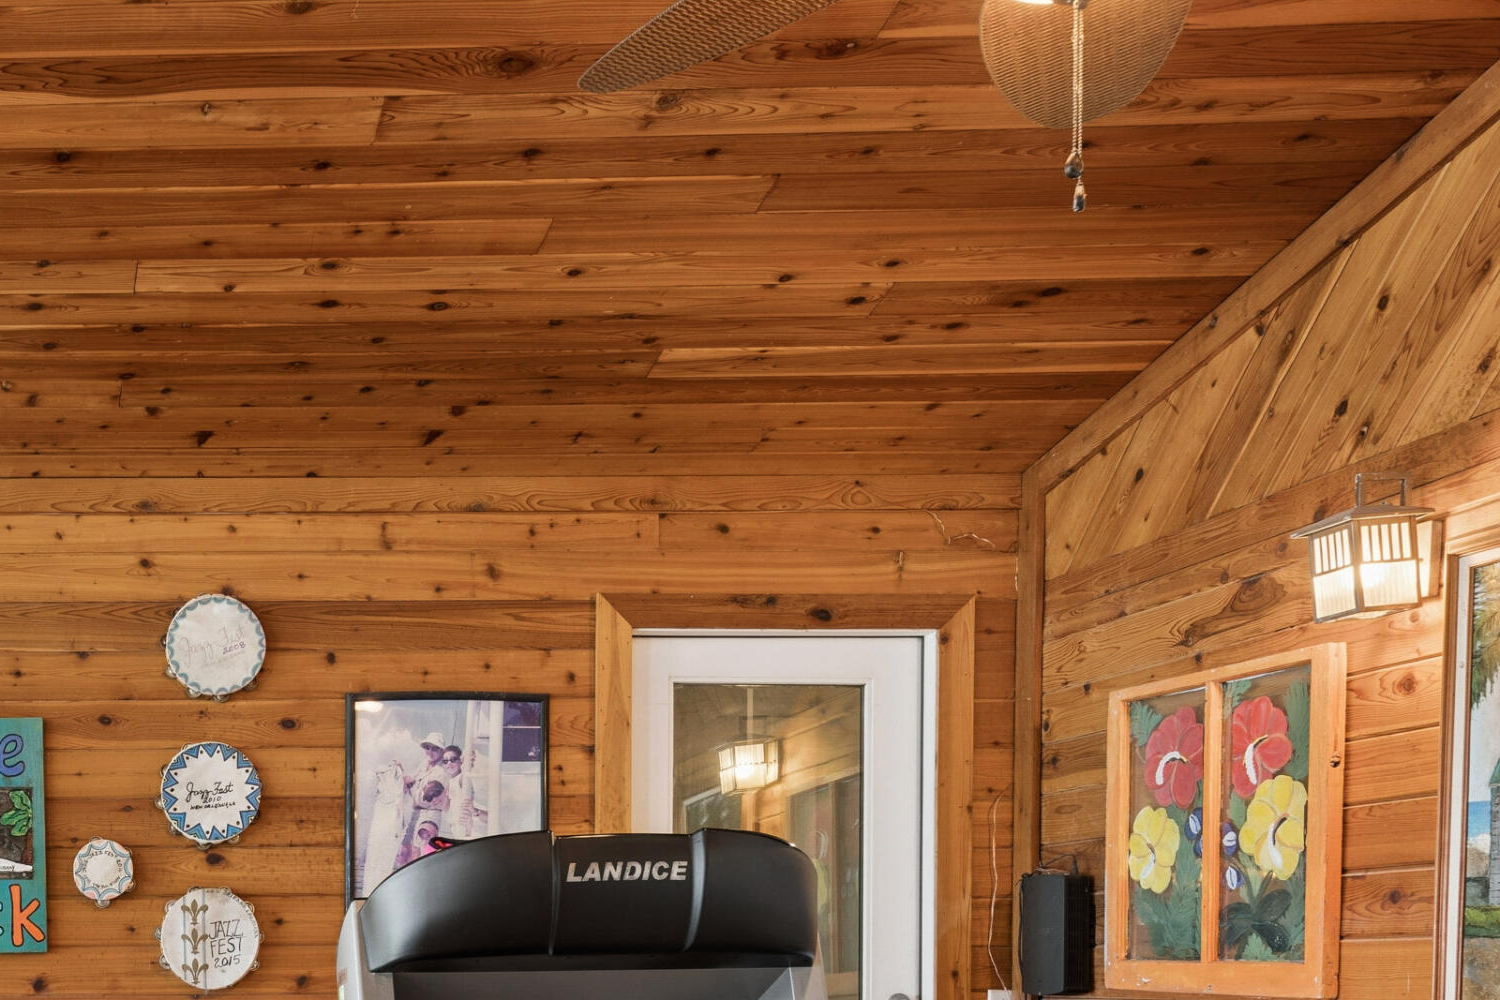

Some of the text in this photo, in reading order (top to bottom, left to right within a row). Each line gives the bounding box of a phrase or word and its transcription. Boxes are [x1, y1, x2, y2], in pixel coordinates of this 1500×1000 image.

[223, 641, 246, 655] 2008
[186, 780, 233, 803] Jazz Fest
[203, 795, 222, 804] 2010
[566, 861, 688, 883] LANDICE
[208, 919, 244, 940] JAZZ
[210, 937, 242, 958] FEST
[214, 953, 241, 969] 2015
